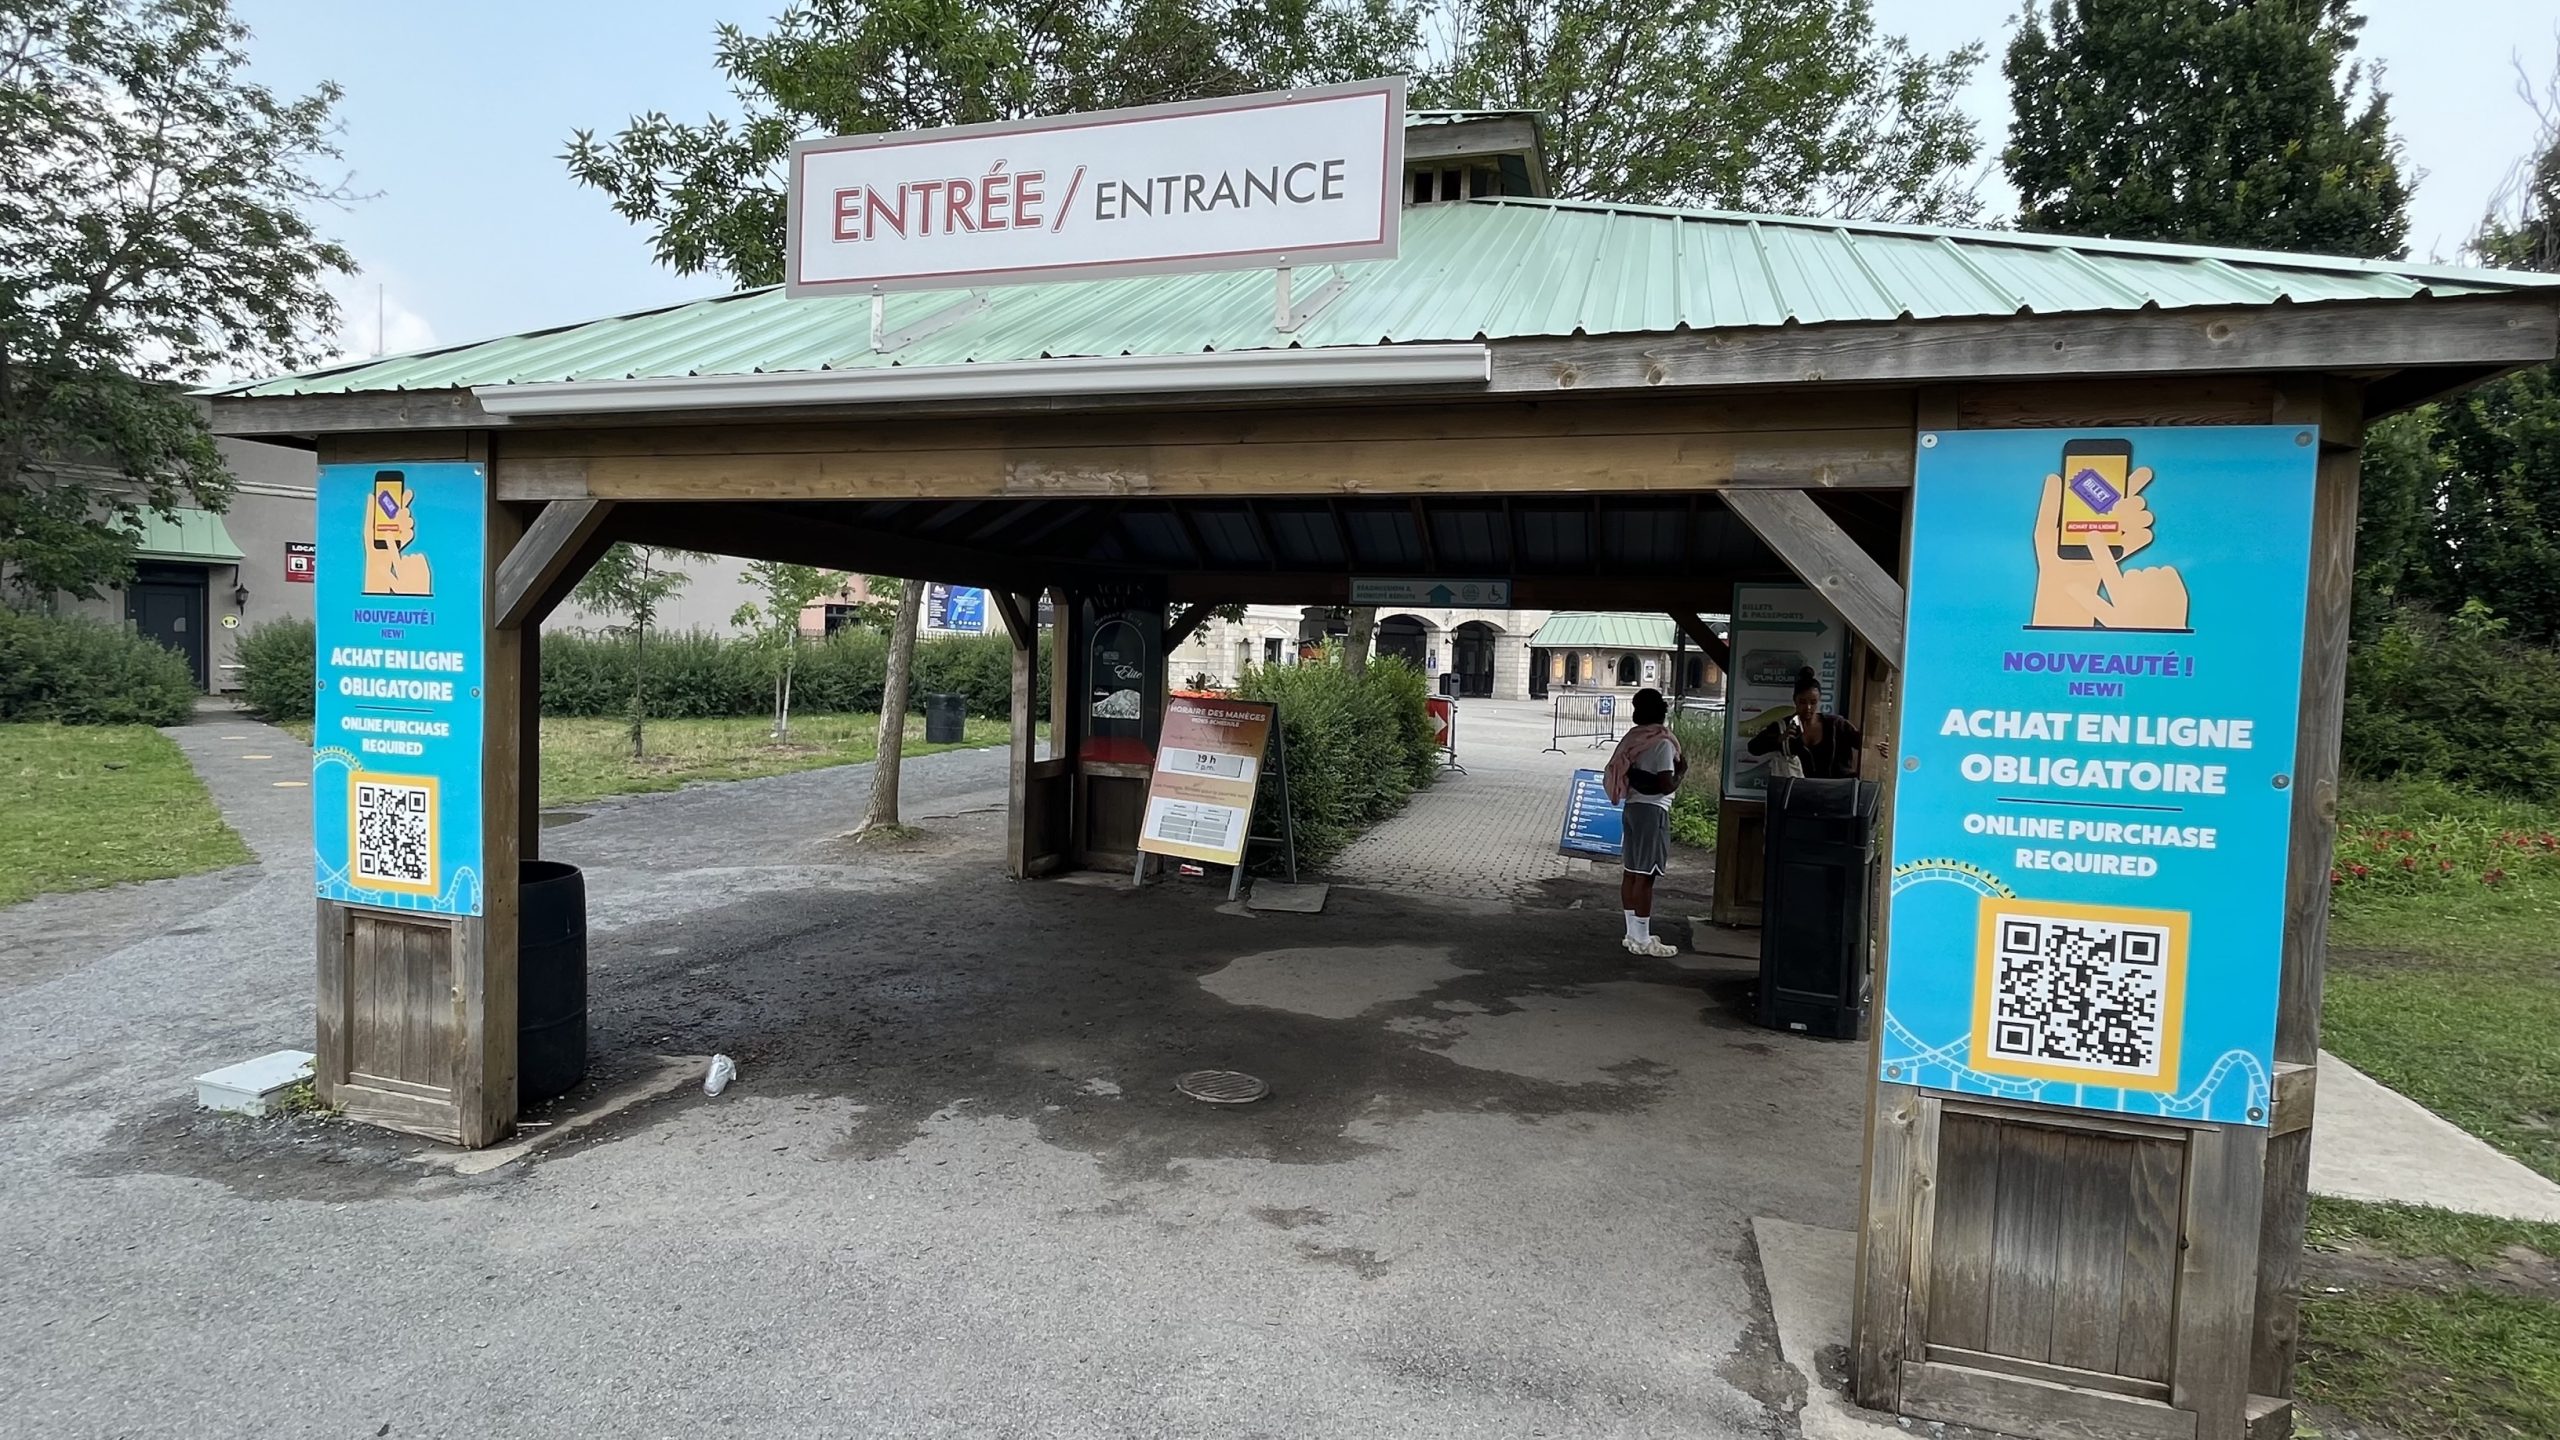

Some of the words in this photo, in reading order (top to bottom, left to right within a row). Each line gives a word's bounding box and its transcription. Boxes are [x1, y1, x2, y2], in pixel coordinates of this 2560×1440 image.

[833, 159, 1045, 243] ENTRÉE
[1095, 159, 1346, 221] ENTRANCE
[2082, 477, 2111, 503] BILLET
[354, 609, 429, 625] NOUVEAUTÉ
[1751, 611, 1804, 619] PASSEPORTS
[381, 628, 405, 639] NEW!
[331, 647, 383, 668] ACHAT
[385, 649, 408, 669] EN
[410, 651, 464, 672] LIGNE
[1763, 667, 1786, 675] BILLET
[2003, 651, 2179, 677] NOUVEAUTÉ
[339, 676, 453, 702] OBLIGATOIRE
[1819, 651, 1836, 714] GULIÈRE
[2068, 682, 2123, 697] NEW!
[1170, 705, 1206, 716] HORAIRE
[1208, 709, 1225, 718] DES
[1225, 710, 1266, 722] MANÈGES
[341, 716, 382, 733] ONLINE
[383, 719, 450, 737] PURCHASE
[1940, 708, 2072, 741] ACHAT
[2077, 713, 2130, 744] EN
[2136, 716, 2253, 749] LIGNE
[362, 738, 424, 756] REQUIRED
[1197, 754, 1208, 763] 19
[1209, 755, 1217, 764] h
[1960, 753, 2227, 795] OBLIGATOIRE
[1963, 814, 2064, 839] ONLINE
[2068, 820, 2217, 849] PURCHASE
[2015, 848, 2158, 877] REQUIRED
